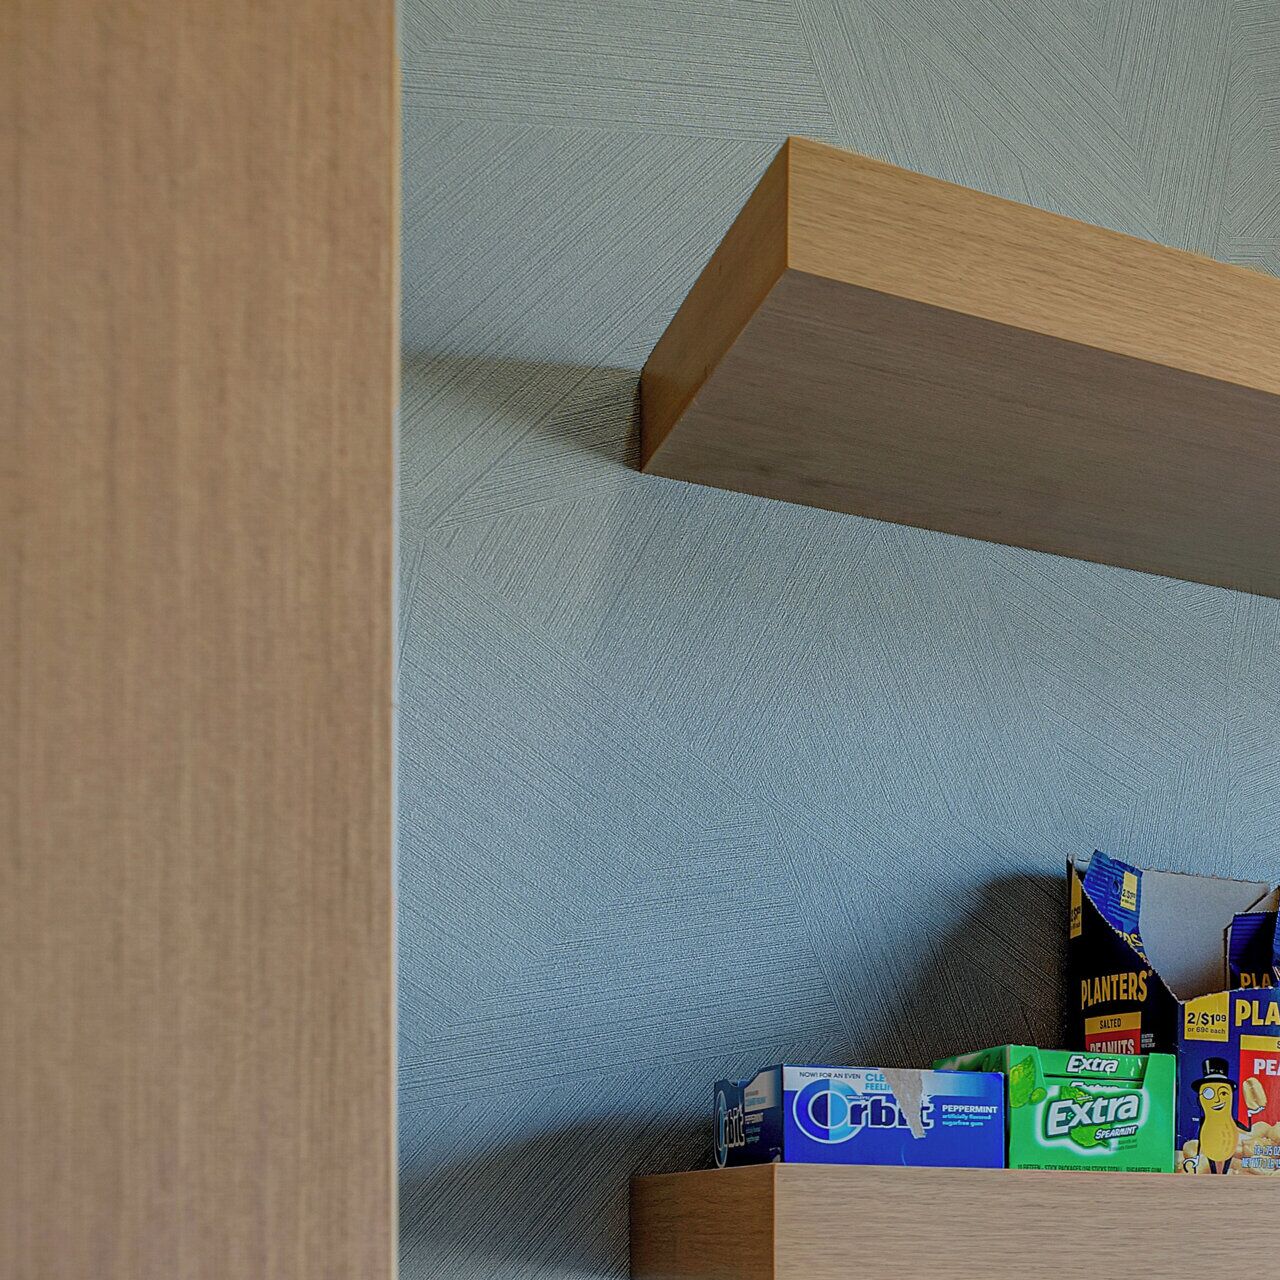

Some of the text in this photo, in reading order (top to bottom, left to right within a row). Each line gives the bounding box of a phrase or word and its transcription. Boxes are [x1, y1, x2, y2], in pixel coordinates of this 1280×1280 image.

[1081, 970, 1148, 1010] PLANTERS
[1099, 1018, 1122, 1029] SALTED
[1210, 1027, 1226, 1035] each
[1066, 1054, 1119, 1073] Extra
[942, 1104, 998, 1113] PEPPERMINT
[1046, 1094, 1141, 1138] Extra
[1094, 1125, 1138, 1140] SPEARMINT
